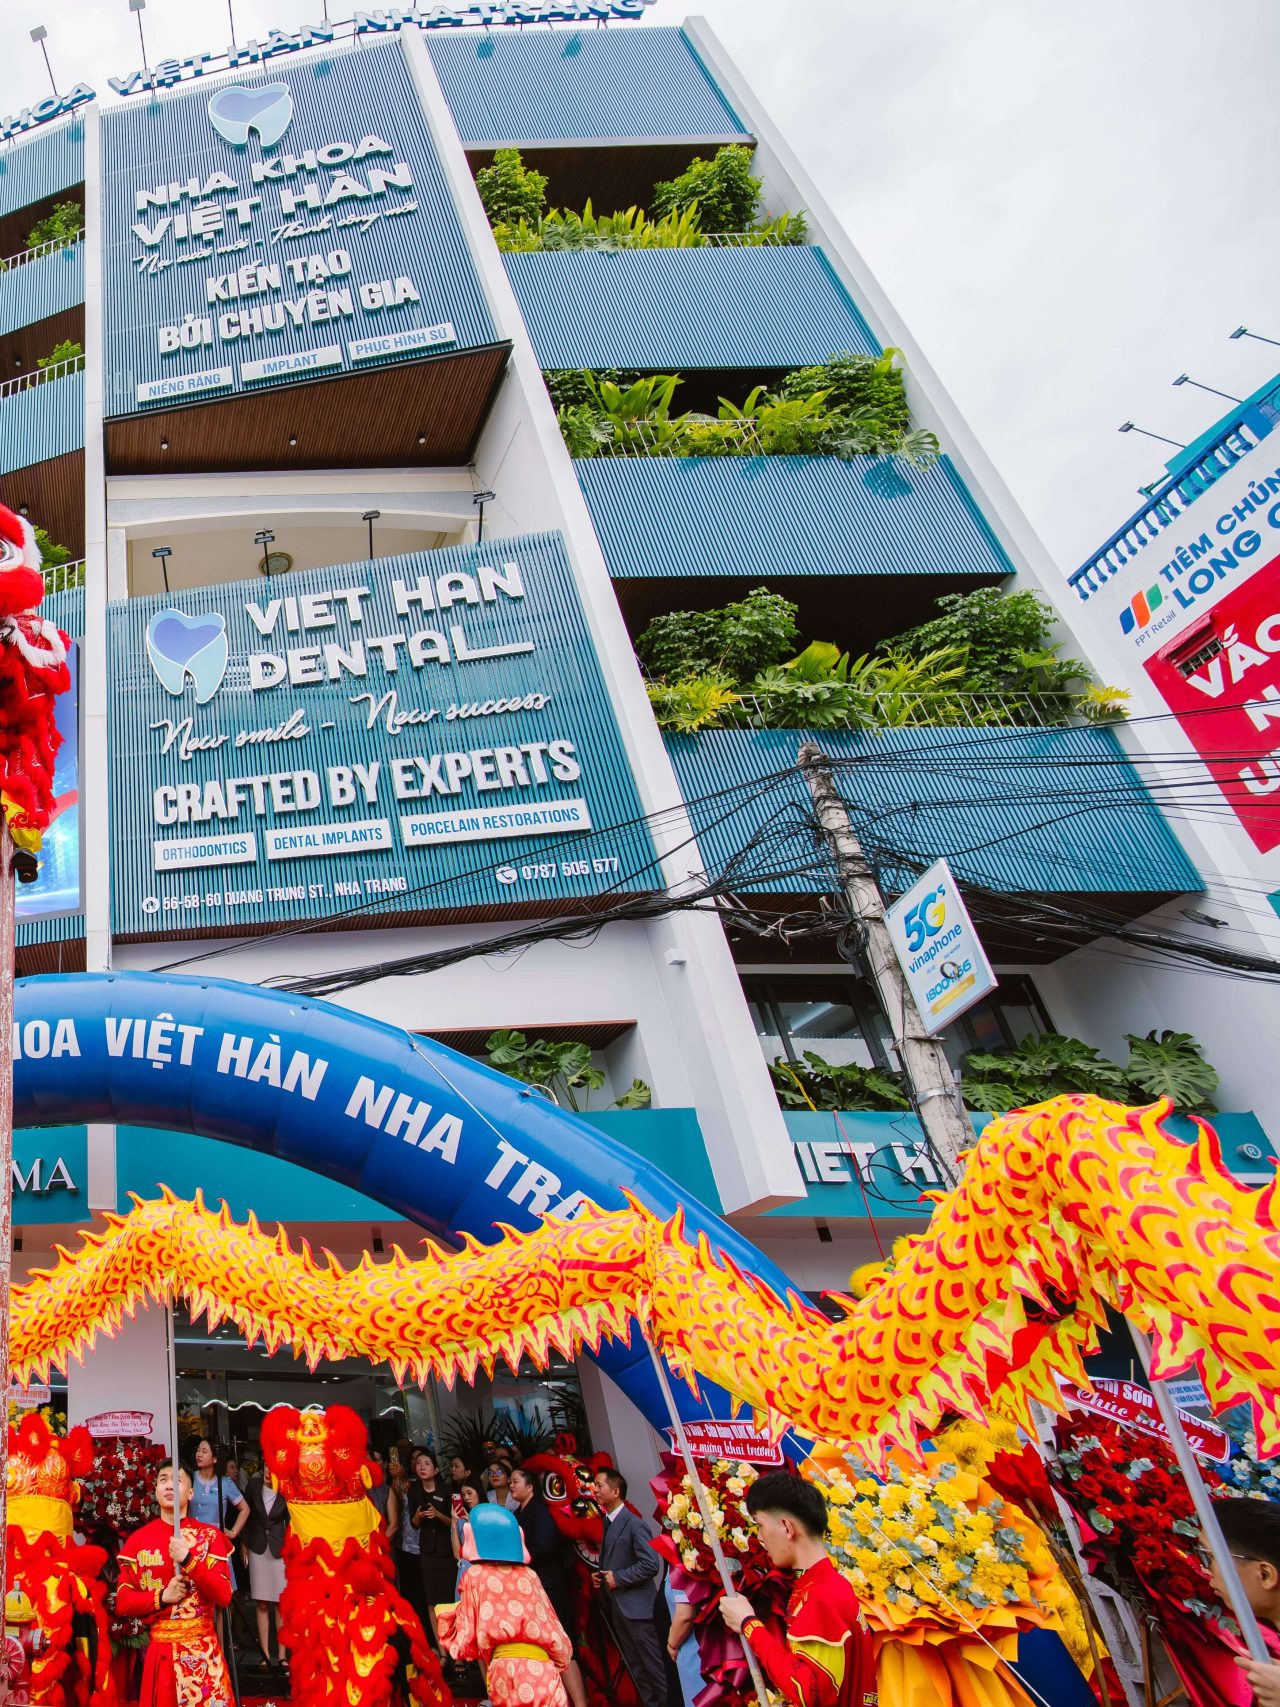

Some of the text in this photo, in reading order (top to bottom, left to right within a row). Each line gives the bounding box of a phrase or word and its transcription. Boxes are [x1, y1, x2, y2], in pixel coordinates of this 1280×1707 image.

[107, 51, 211, 96] VIỆT
[227, 19, 334, 67] HÀN
[353, 5, 463, 33] NHA
[468, 0, 647, 25] TRANG
[136, 134, 394, 213] NHA KHOA
[131, 162, 415, 248] VIỆT HÀN
[206, 249, 353, 303] KIẾN TẠO
[159, 276, 421, 354] BỞI CHUYÊN GIA
[262, 353, 318, 375] IMPLANT
[355, 339, 391, 359] PHỤC
[392, 331, 426, 350] HÌNH
[187, 374, 222, 389] RĂNG
[1159, 533, 1213, 584] TIÊM
[1173, 530, 1261, 610] LONG
[244, 561, 525, 636] VIET HAN
[1135, 609, 1178, 648] FPT Retail
[249, 625, 535, 691] DENTAL
[150, 716, 229, 761] New
[234, 707, 312, 749] smile
[349, 689, 440, 735] New
[445, 690, 552, 724] success
[154, 739, 582, 826] CRAFTED BY EXPERTS
[273, 825, 384, 851] DENTAL IMPLANTS
[411, 806, 580, 838] PORCELAIN RESTORATIONS
[162, 841, 249, 861] ORTHODONTICS
[521, 857, 619, 882] 0787 505 577
[162, 893, 223, 911] 56-58-60
[223, 888, 265, 908] QUANG
[265, 884, 307, 903] TRUNG
[334, 880, 362, 897] NHA
[363, 876, 408, 893] TRANG
[908, 922, 963, 975] vinaphone
[105, 1013, 205, 1071] VIỆT
[216, 1032, 330, 1103] HÀN
[343, 1075, 465, 1167] NHA
[798, 1141, 876, 1183] IET
[1076, 1387, 1129, 1419] Chúc
[724, 1440, 746, 1456] khai
